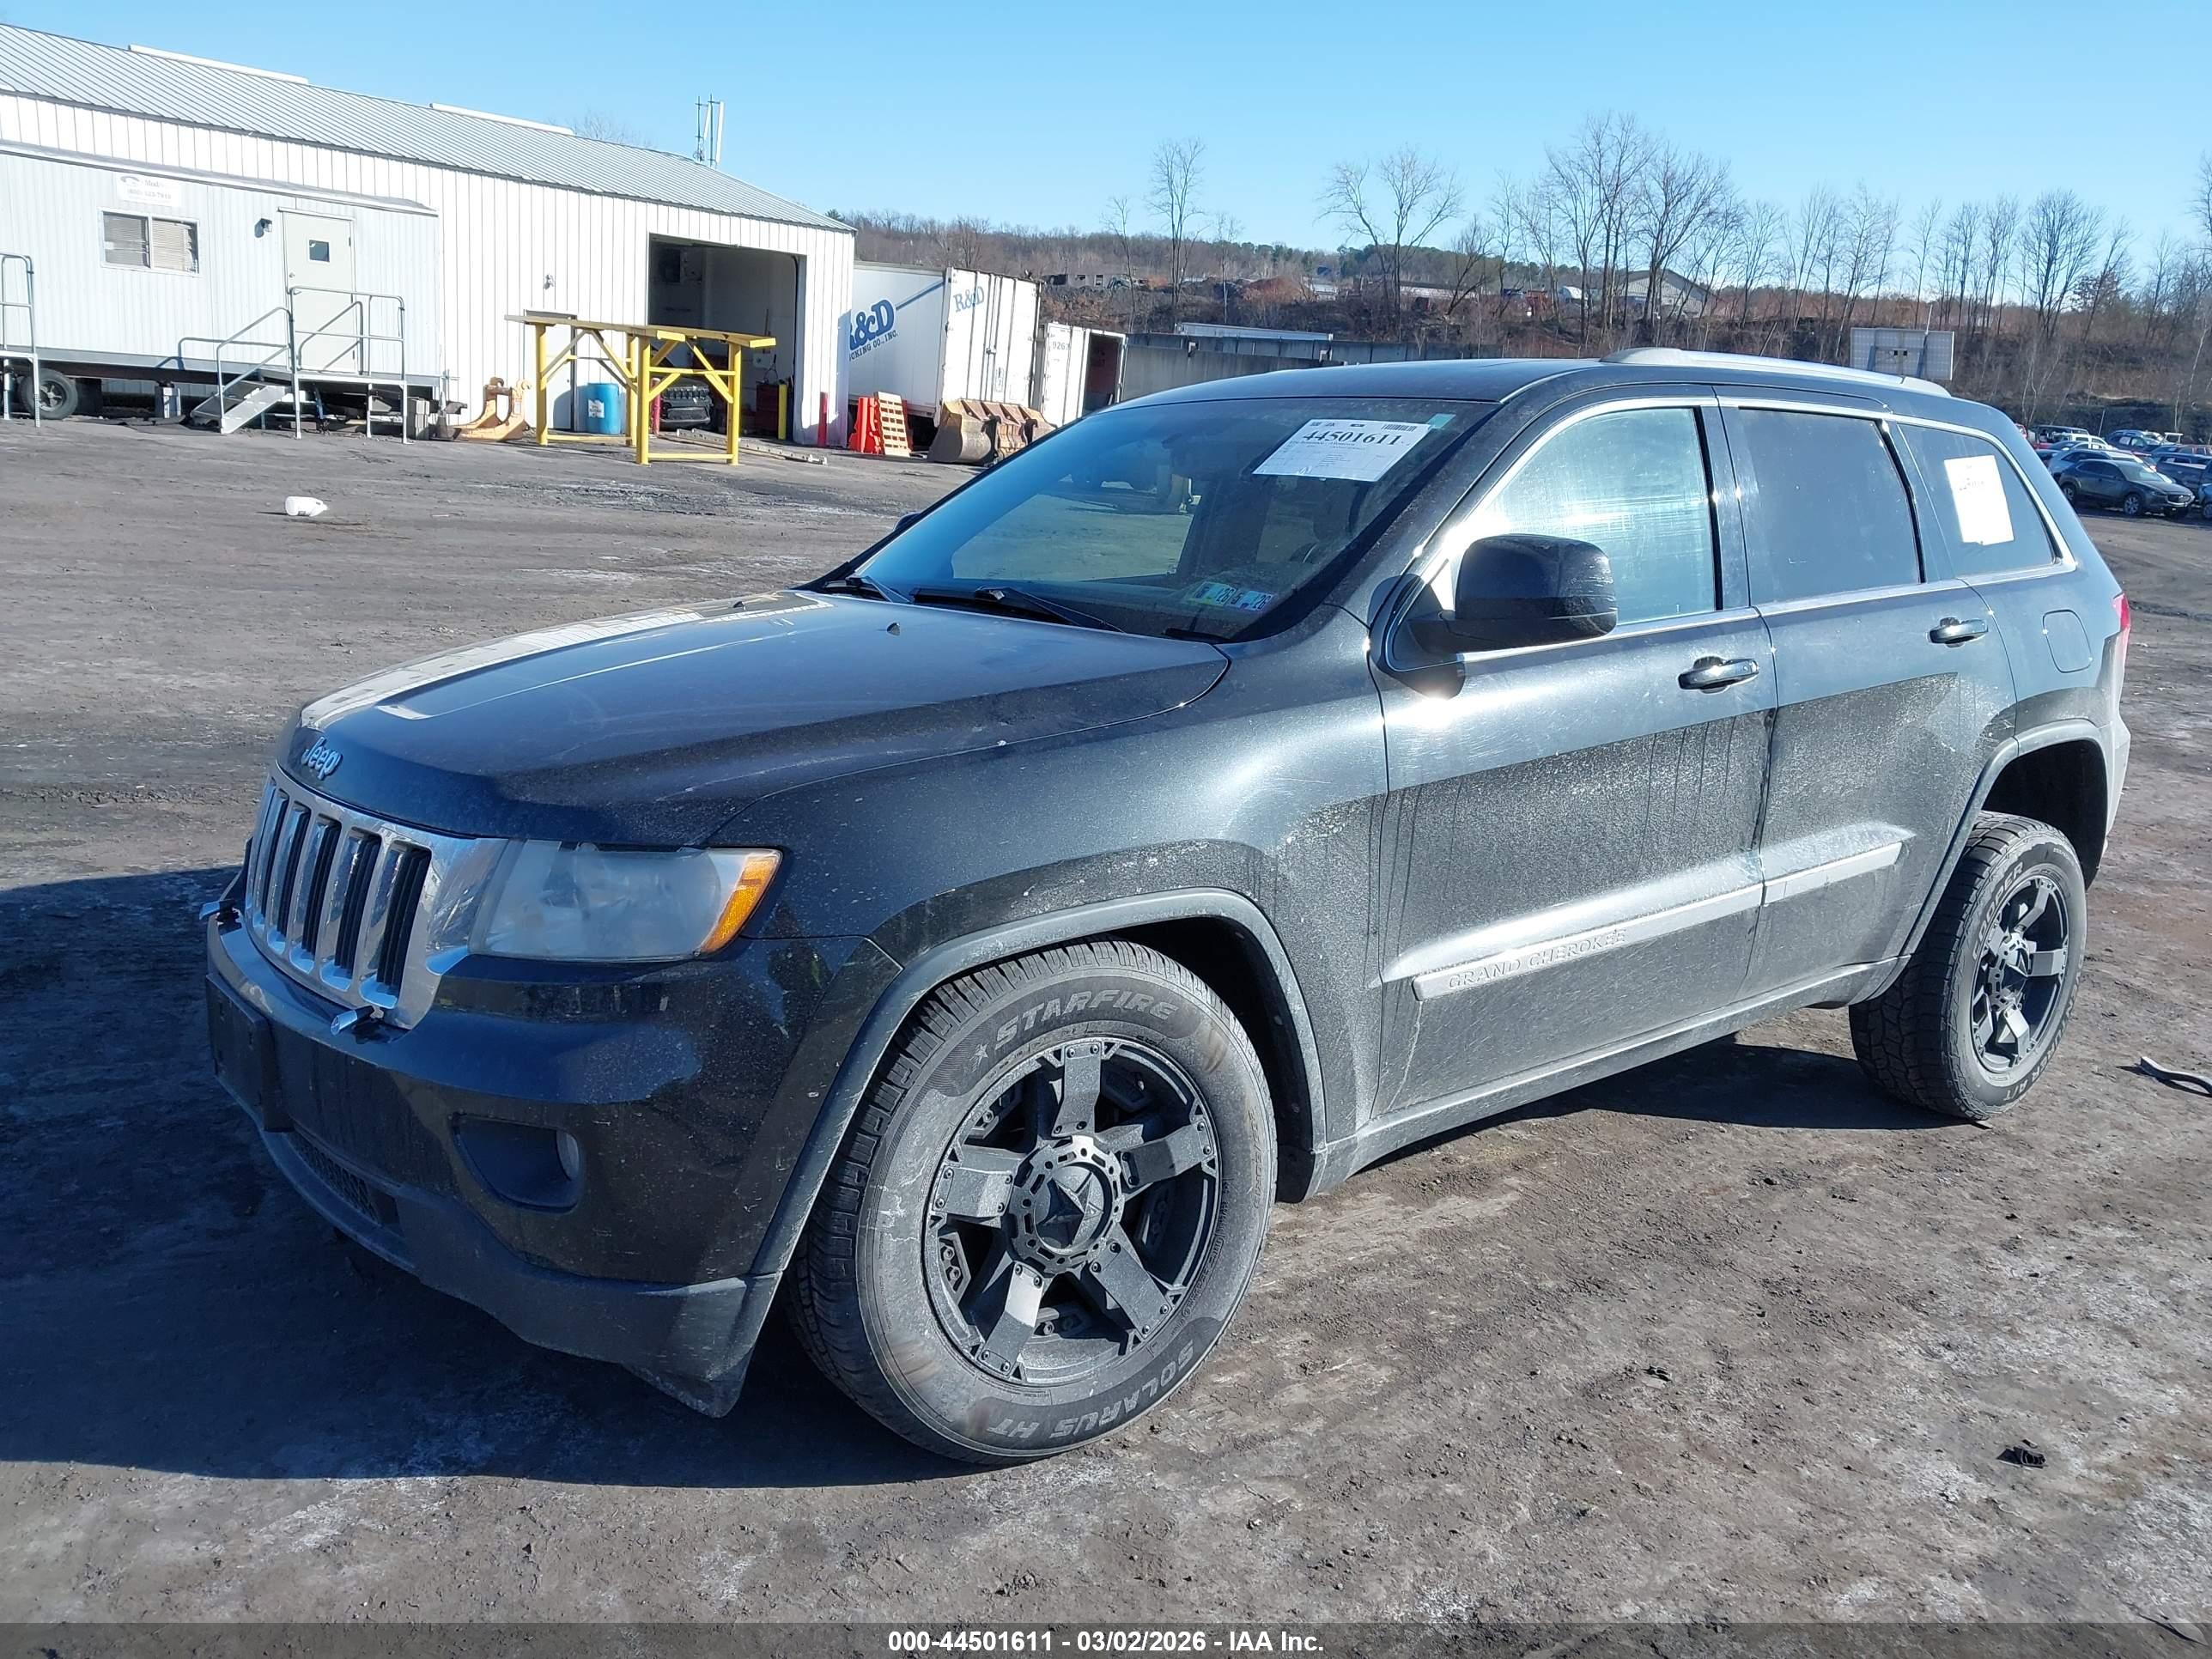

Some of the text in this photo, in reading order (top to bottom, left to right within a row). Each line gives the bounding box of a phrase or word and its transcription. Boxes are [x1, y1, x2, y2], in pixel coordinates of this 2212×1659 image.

[953, 286, 985, 313] R&D
[1303, 430, 1402, 446] 44501611
[301, 736, 341, 780] Jeep
[1972, 861, 2023, 960] COOPER
[1449, 927, 1626, 988] GRAND CHEROKEE
[994, 989, 1179, 1051] STARFIRE
[987, 1340, 1194, 1439] SOLARUS HT
